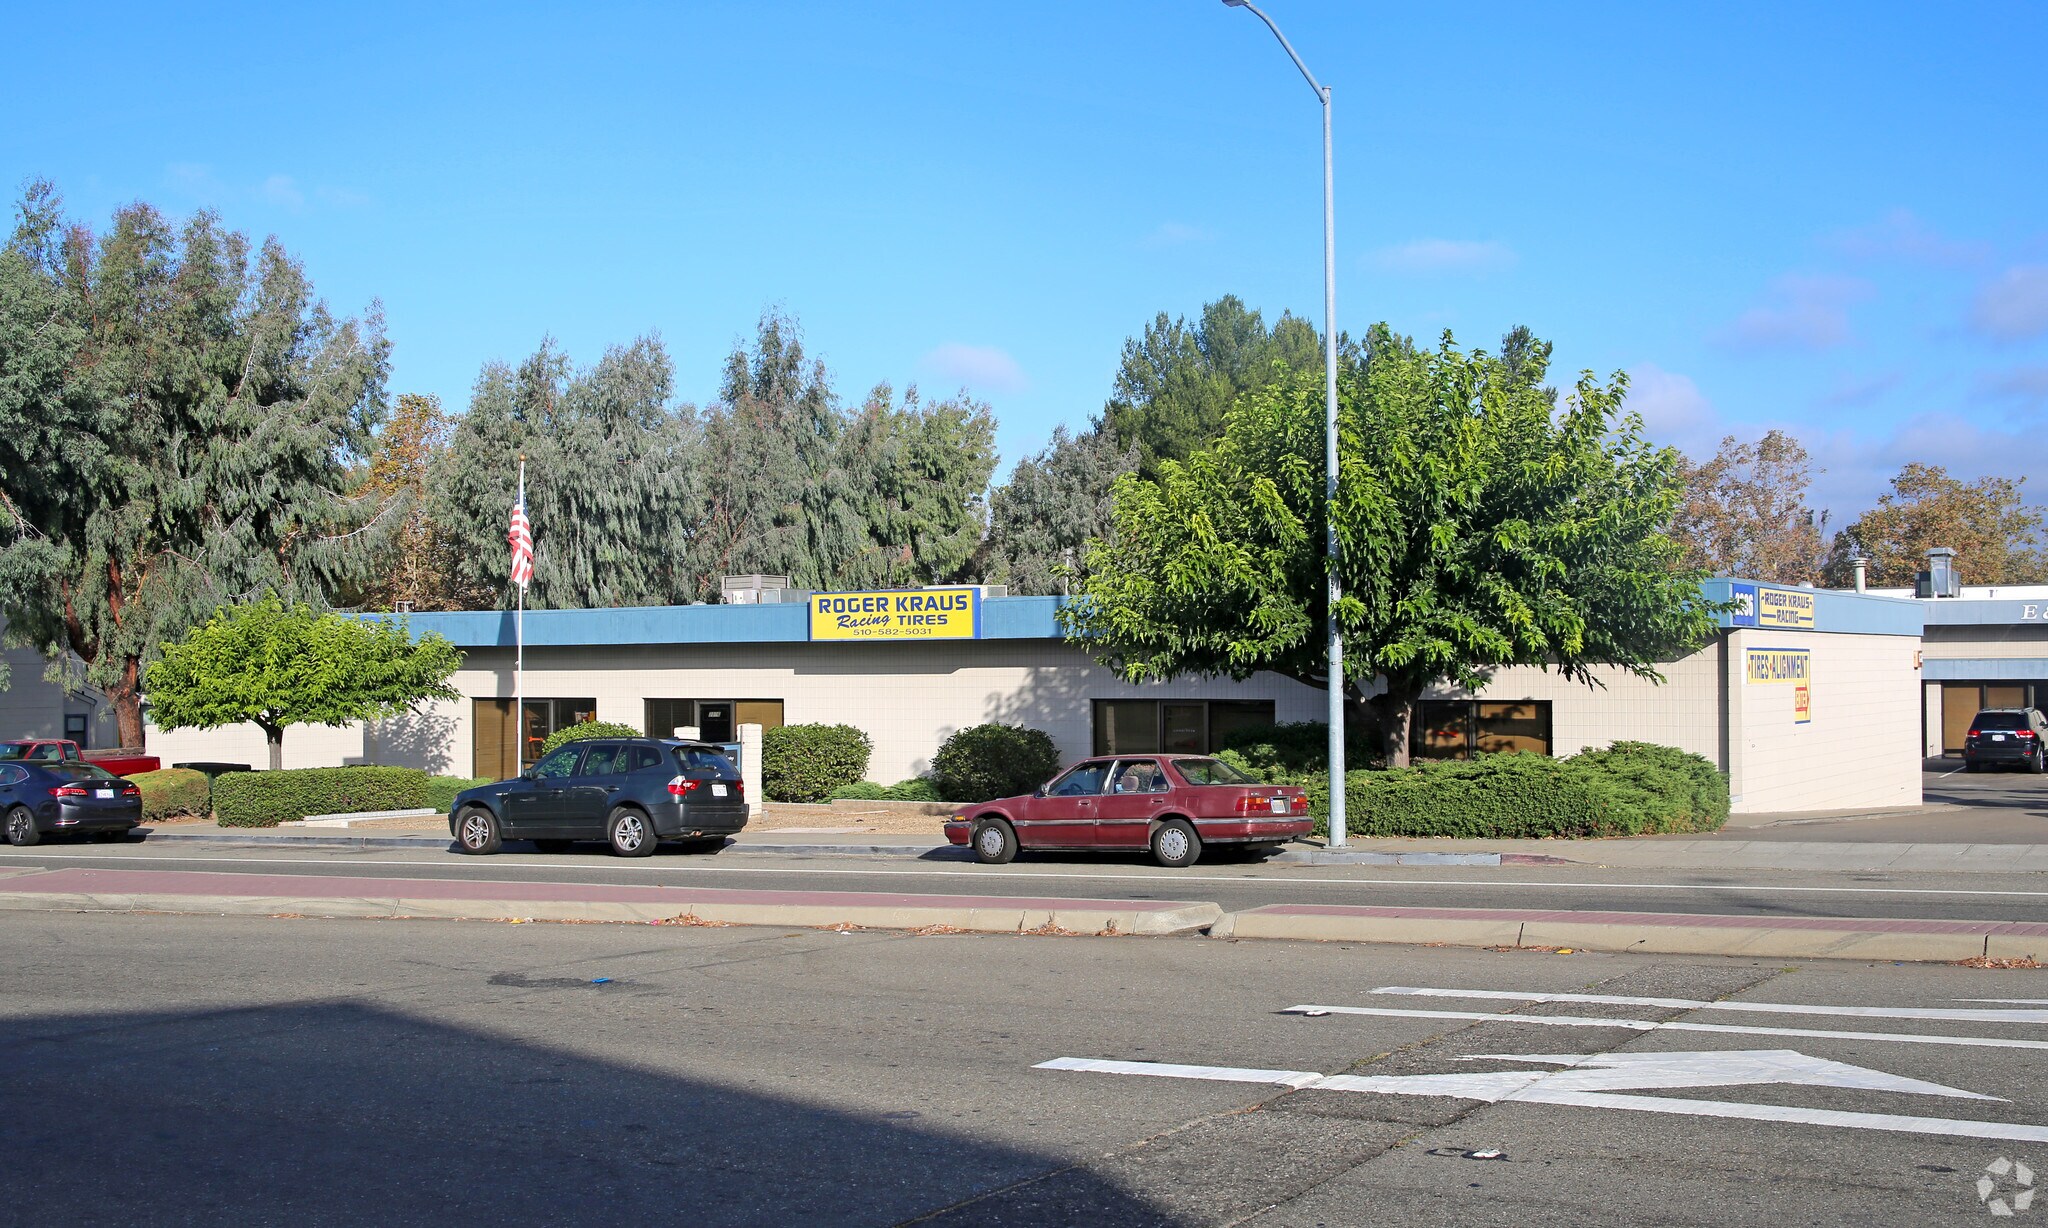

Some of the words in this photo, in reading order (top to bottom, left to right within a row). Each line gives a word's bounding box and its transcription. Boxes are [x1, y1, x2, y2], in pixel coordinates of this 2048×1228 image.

[819, 597, 889, 614] ROGER
[896, 594, 967, 612] KRAUS
[1765, 592, 1787, 607] ROGER
[1788, 594, 1810, 609] KRAUS
[1776, 609, 1799, 624] RACING
[2020, 604, 2038, 620] E
[836, 614, 891, 630] Racing
[897, 614, 948, 626] TIRES
[853, 628, 932, 636] 510-582-5031
